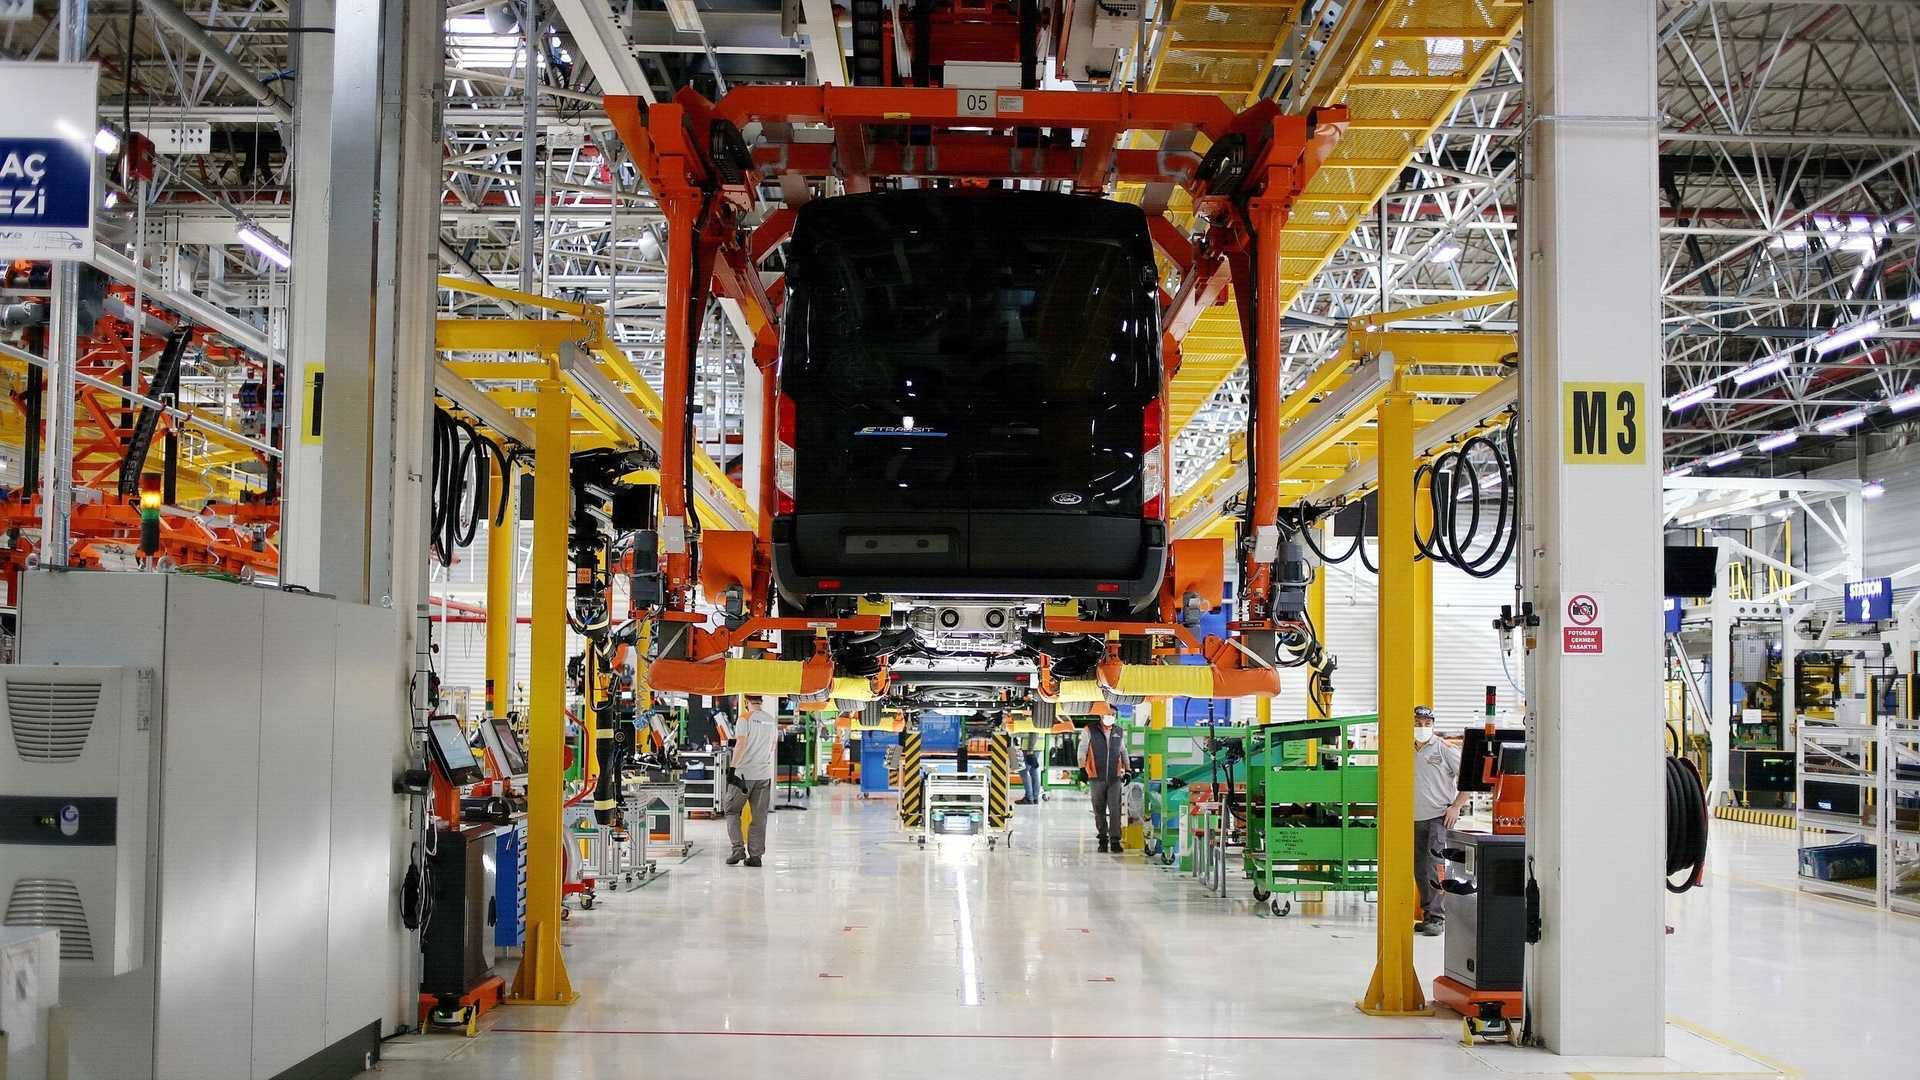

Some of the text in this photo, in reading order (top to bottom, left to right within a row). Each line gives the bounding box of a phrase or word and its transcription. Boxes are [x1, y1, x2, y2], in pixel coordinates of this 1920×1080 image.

[967, 95, 988, 111] 05
[1849, 581, 1883, 598] STATION
[1861, 599, 1871, 620] 2
